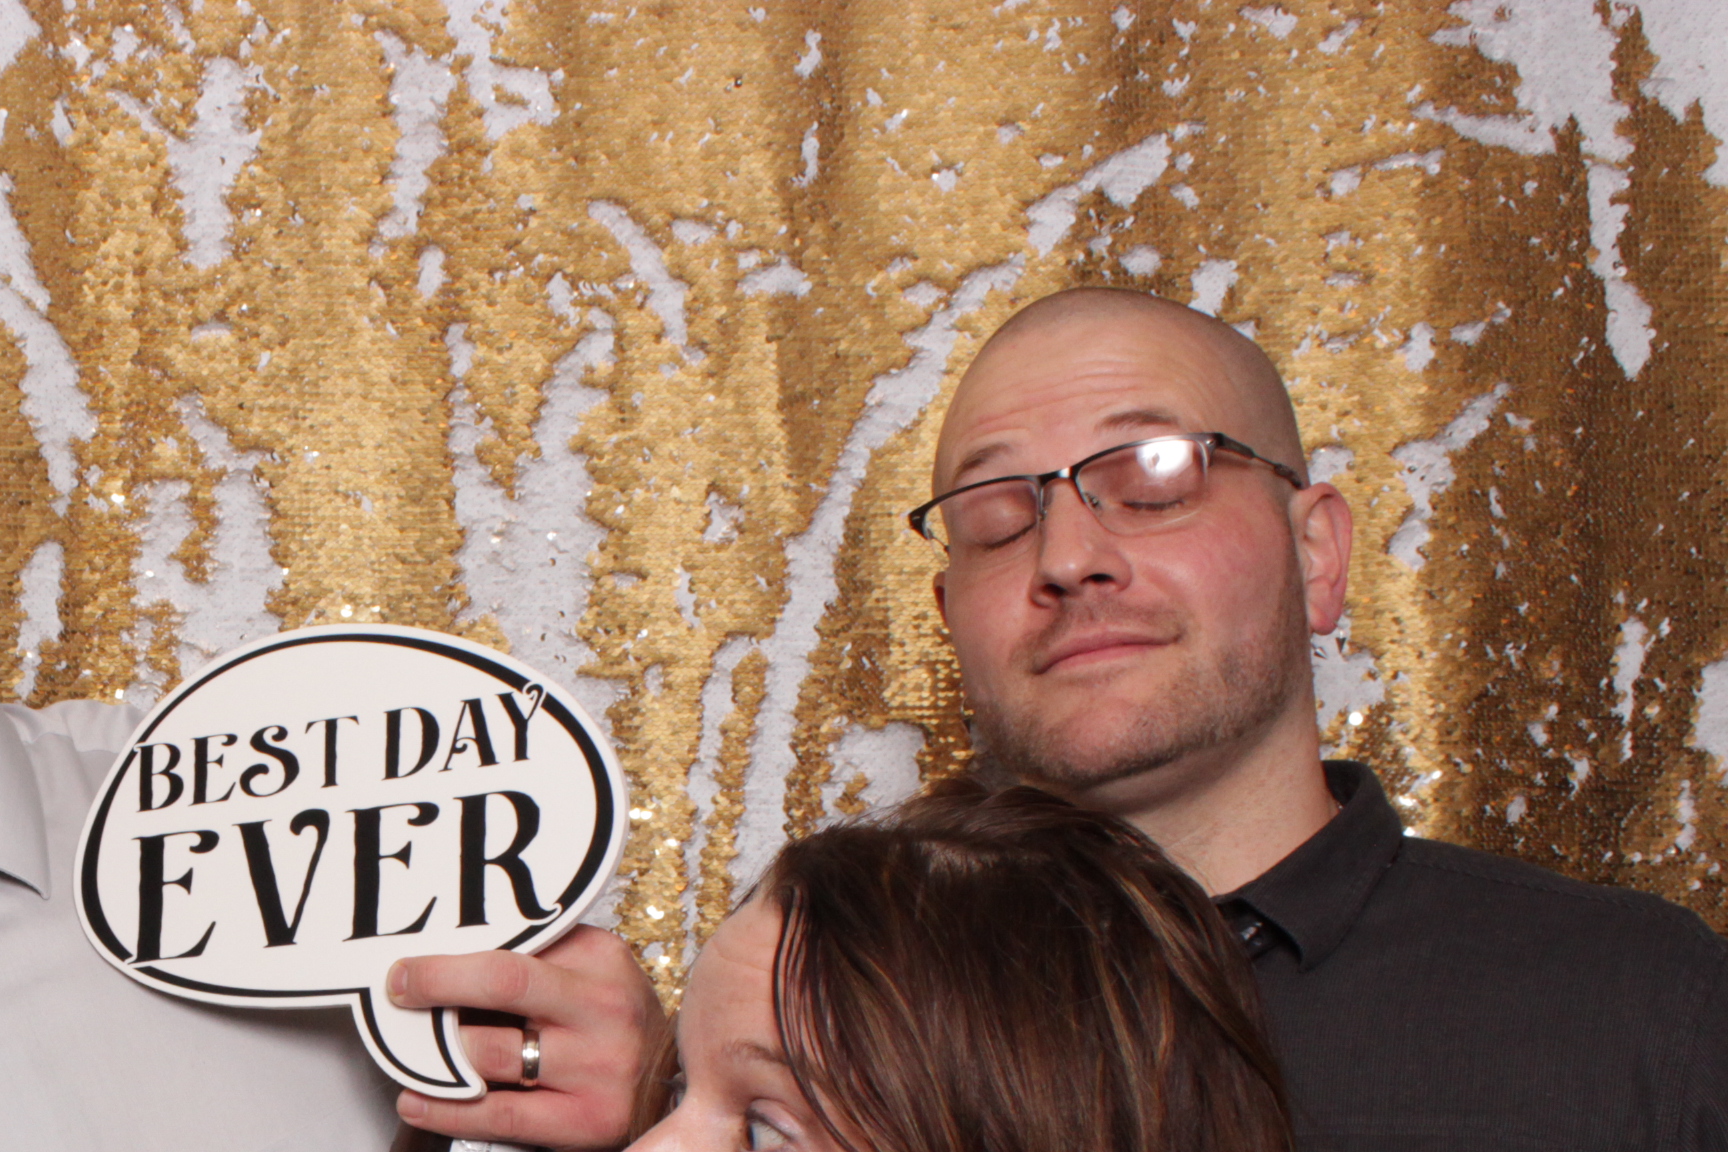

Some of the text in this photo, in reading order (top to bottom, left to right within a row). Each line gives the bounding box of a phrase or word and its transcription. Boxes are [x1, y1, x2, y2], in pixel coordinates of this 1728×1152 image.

[134, 683, 546, 813] BEST DAY
[128, 790, 560, 964] EVER
